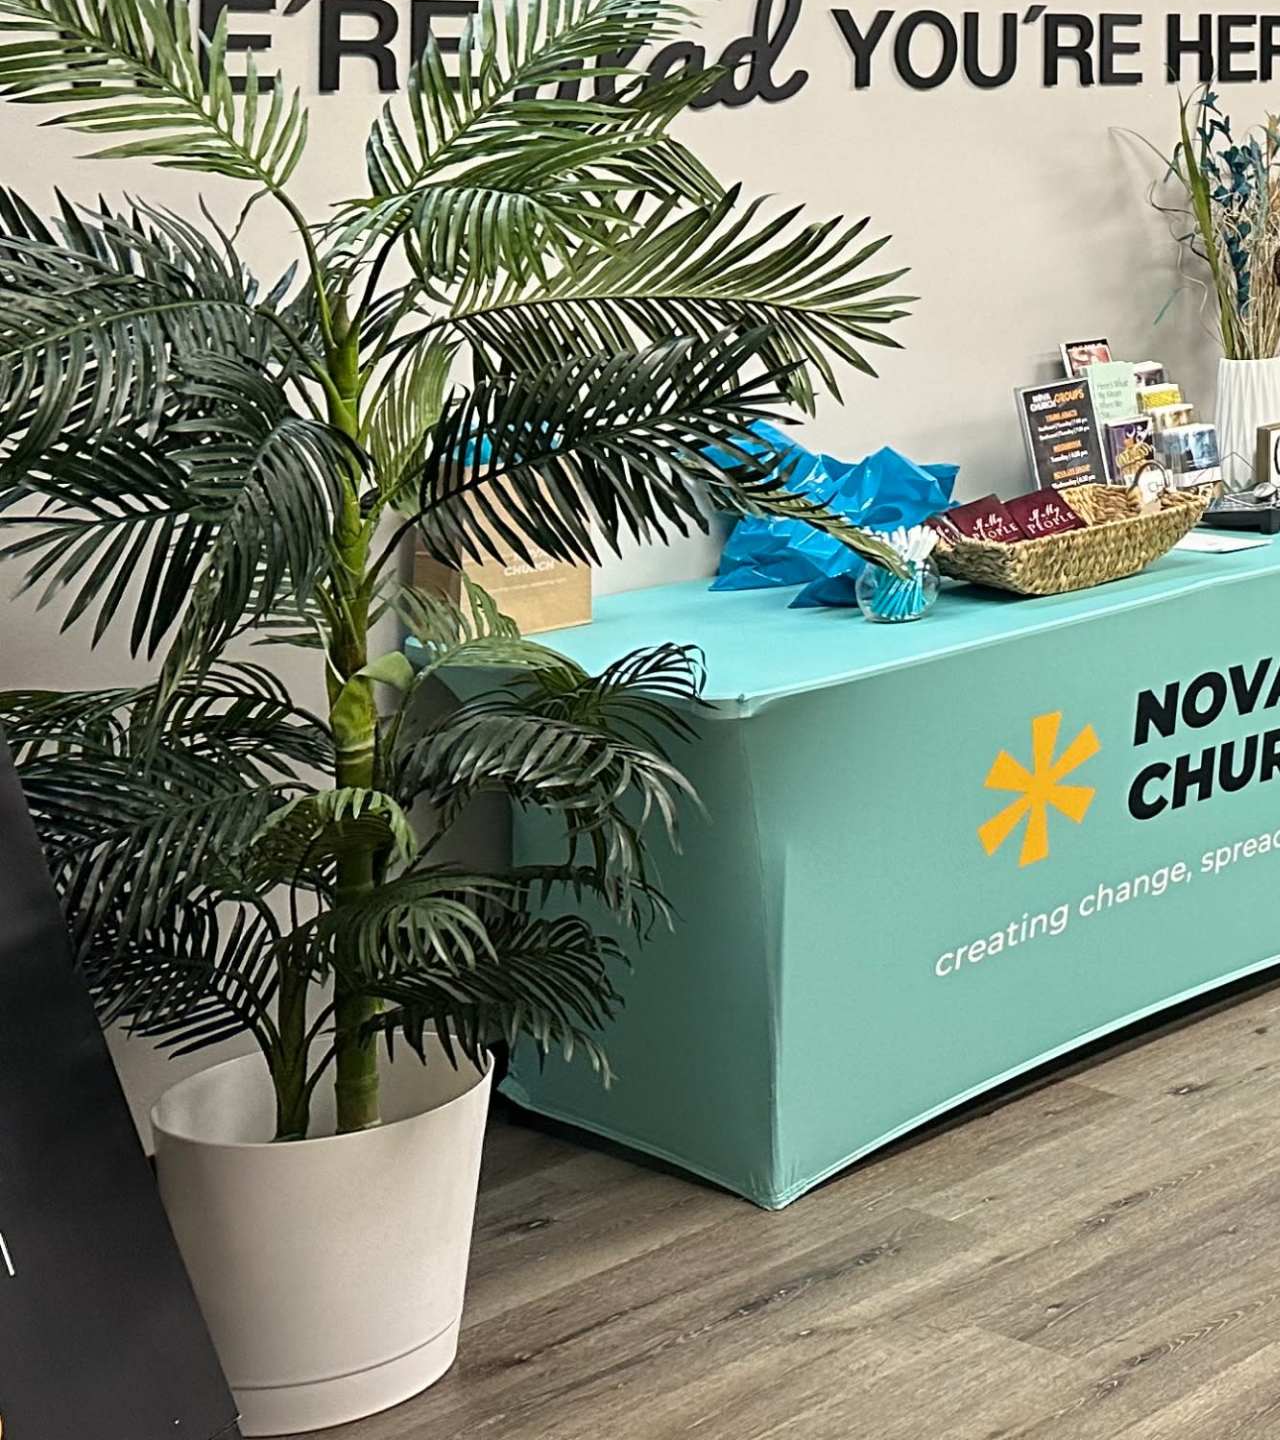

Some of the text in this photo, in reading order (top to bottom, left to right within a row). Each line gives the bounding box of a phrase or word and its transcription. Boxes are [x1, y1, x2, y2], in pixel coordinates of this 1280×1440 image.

[831, 4, 1142, 90] YOU'RE
[934, 903, 1069, 977] creating
[1079, 859, 1192, 917] change,
